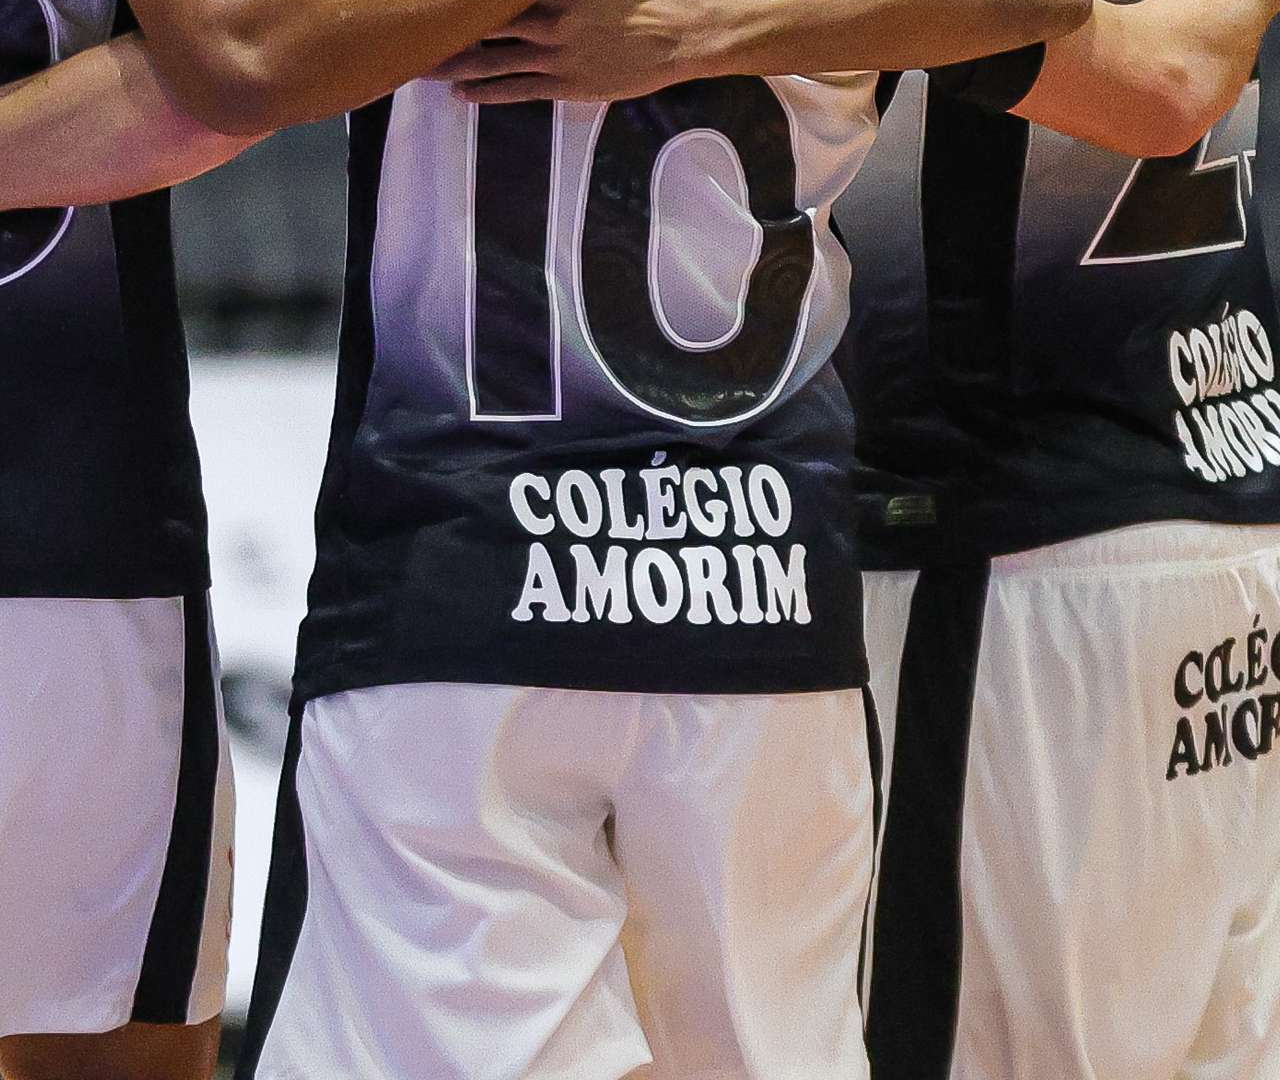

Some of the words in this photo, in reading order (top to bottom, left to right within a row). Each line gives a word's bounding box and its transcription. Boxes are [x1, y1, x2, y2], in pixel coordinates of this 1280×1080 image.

[465, 75, 817, 427] 10
[510, 450, 792, 541] COLÉGIO
[511, 542, 812, 624] AMORIM
